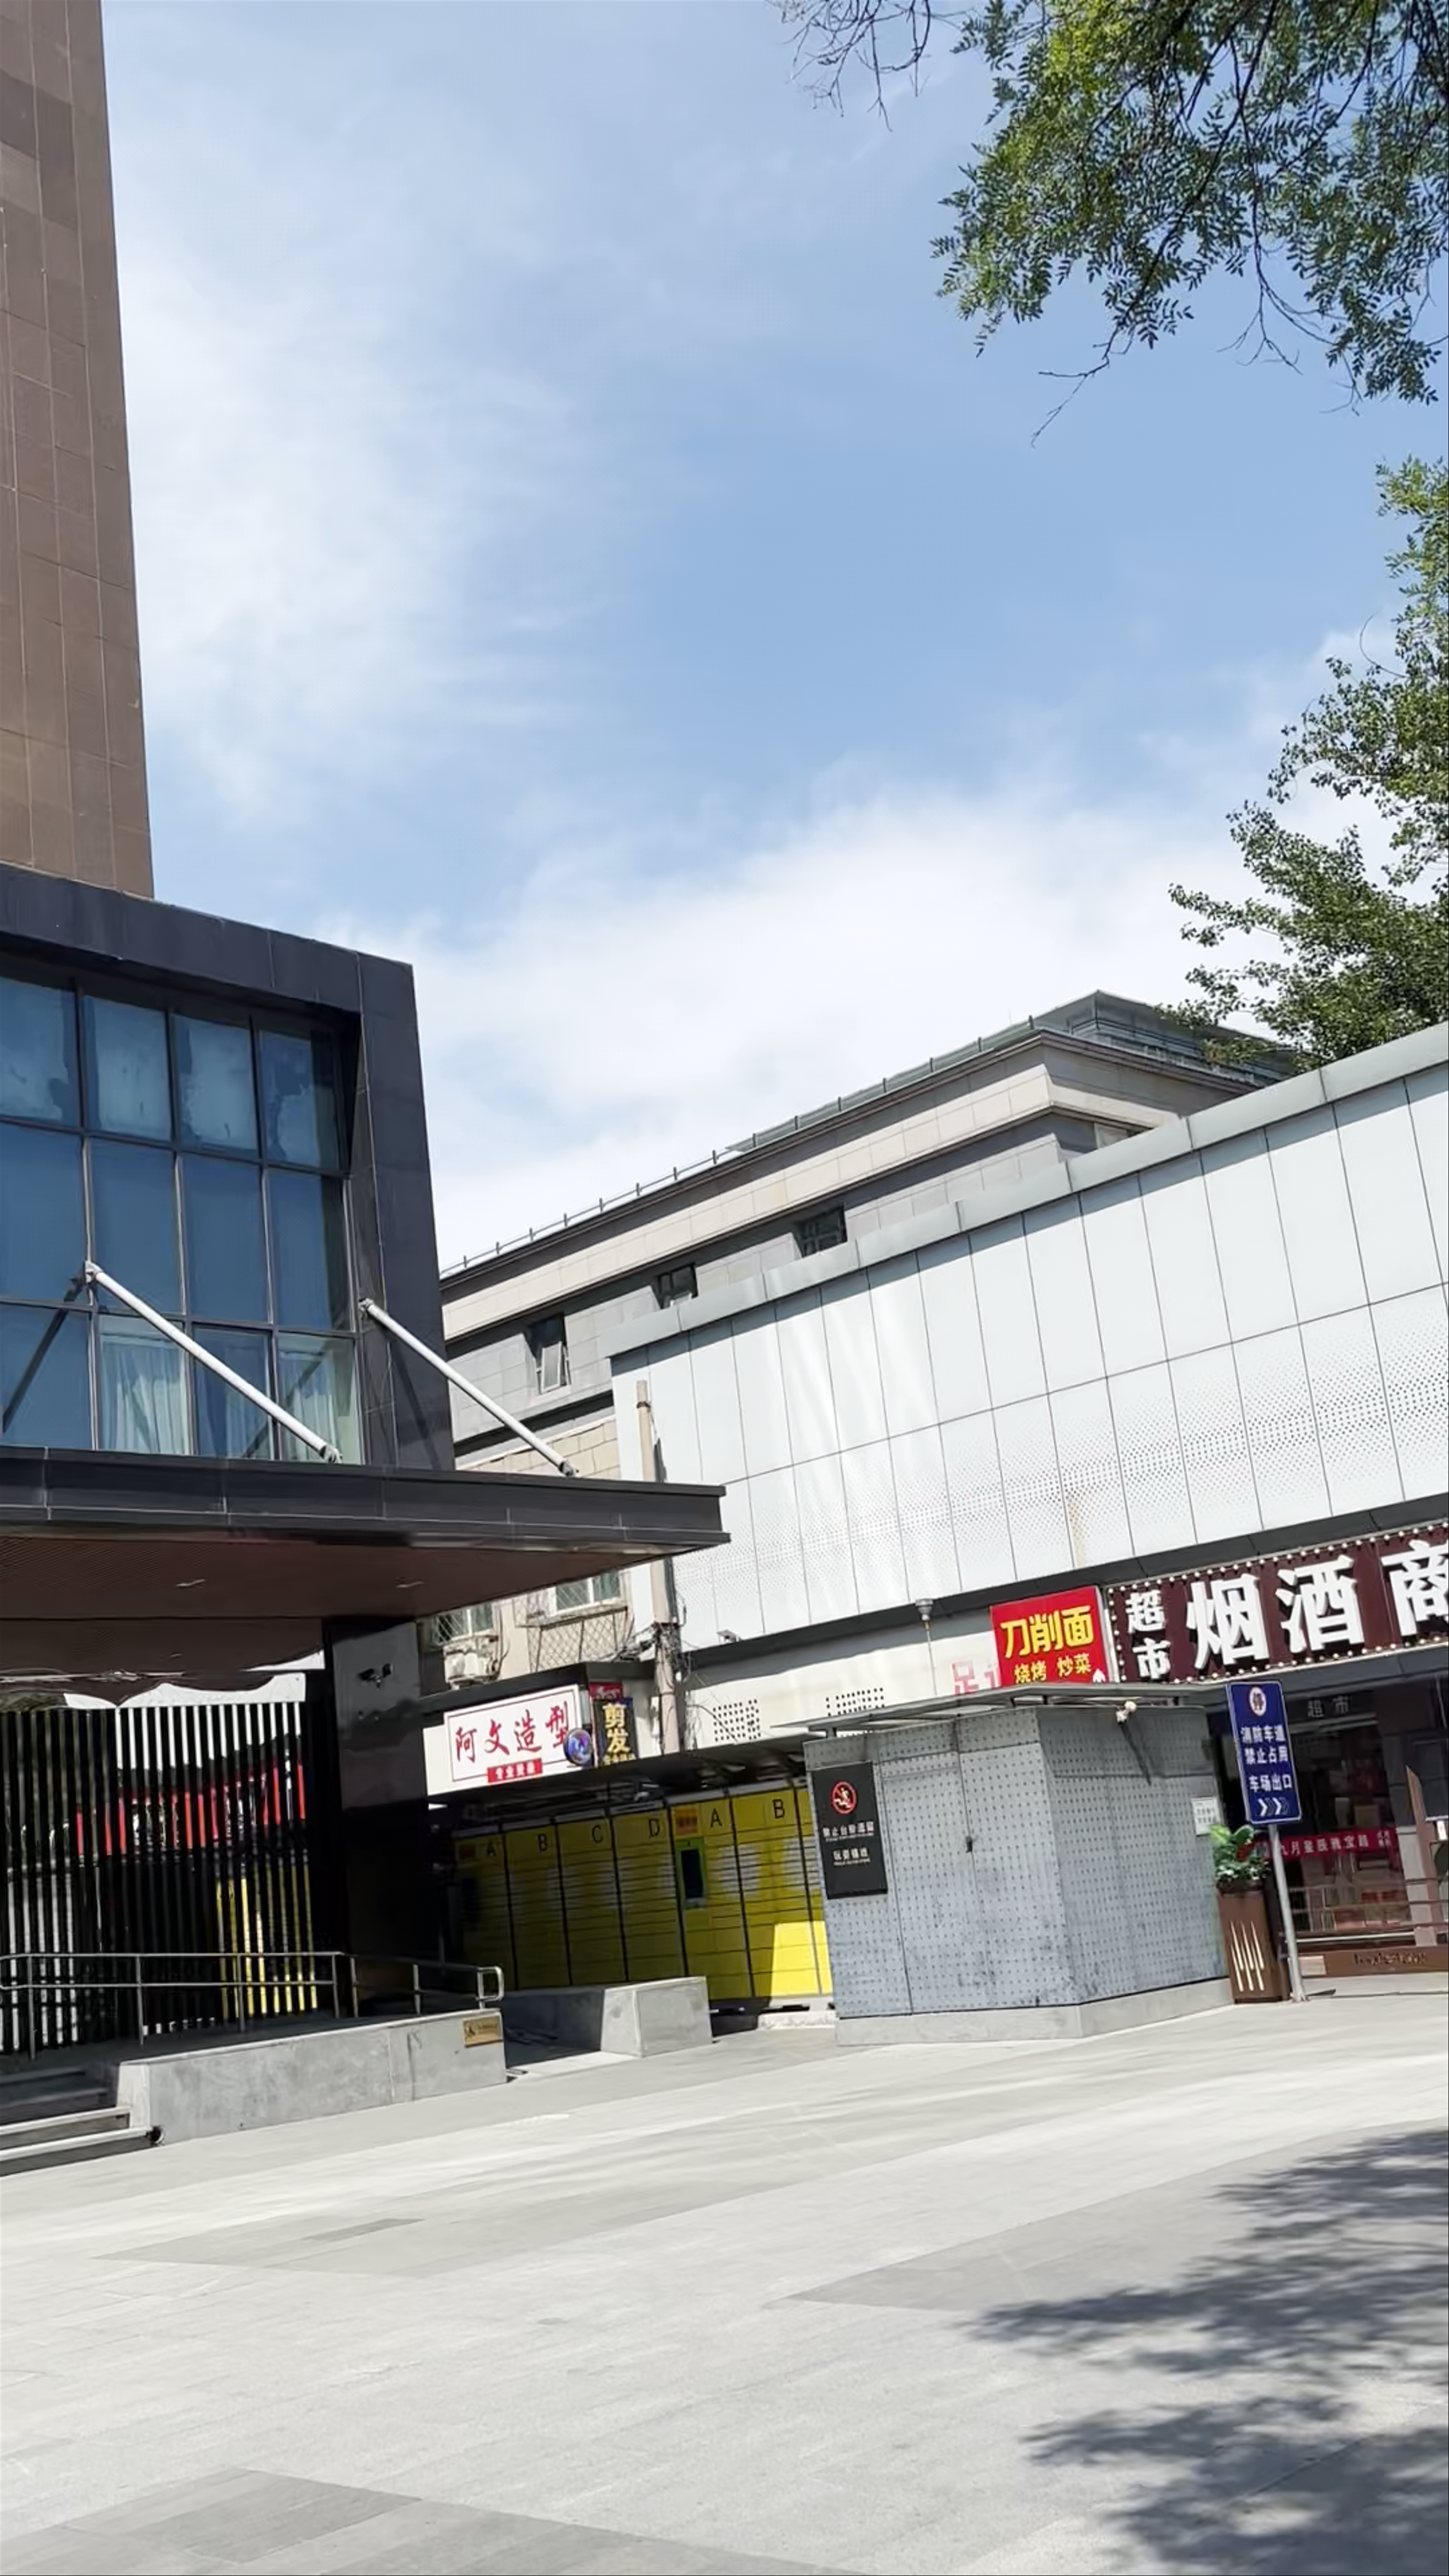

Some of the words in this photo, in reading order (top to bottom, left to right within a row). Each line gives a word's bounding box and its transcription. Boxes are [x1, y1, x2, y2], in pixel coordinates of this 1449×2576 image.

[1186, 1539, 1449, 1670] 烟酒商
[1000, 1605, 1094, 1659] 刀削面
[1125, 1589, 1171, 1679] 超市
[1014, 1660, 1047, 1684] 烧烤
[1057, 1653, 1092, 1677] 炒菜
[1308, 1695, 1349, 1717] 超市
[455, 1701, 569, 1763] 阿文造型
[602, 1703, 631, 1753] 剪发
[1240, 1725, 1286, 1744] 消防车道
[1244, 1746, 1288, 1765] 禁止占用
[1248, 1773, 1292, 1792] 车场出口
[710, 1808, 723, 1828] A
[772, 1798, 785, 1819] B
[591, 1824, 603, 1844] C
[648, 1819, 660, 1838] D
[538, 1833, 548, 1852] B
